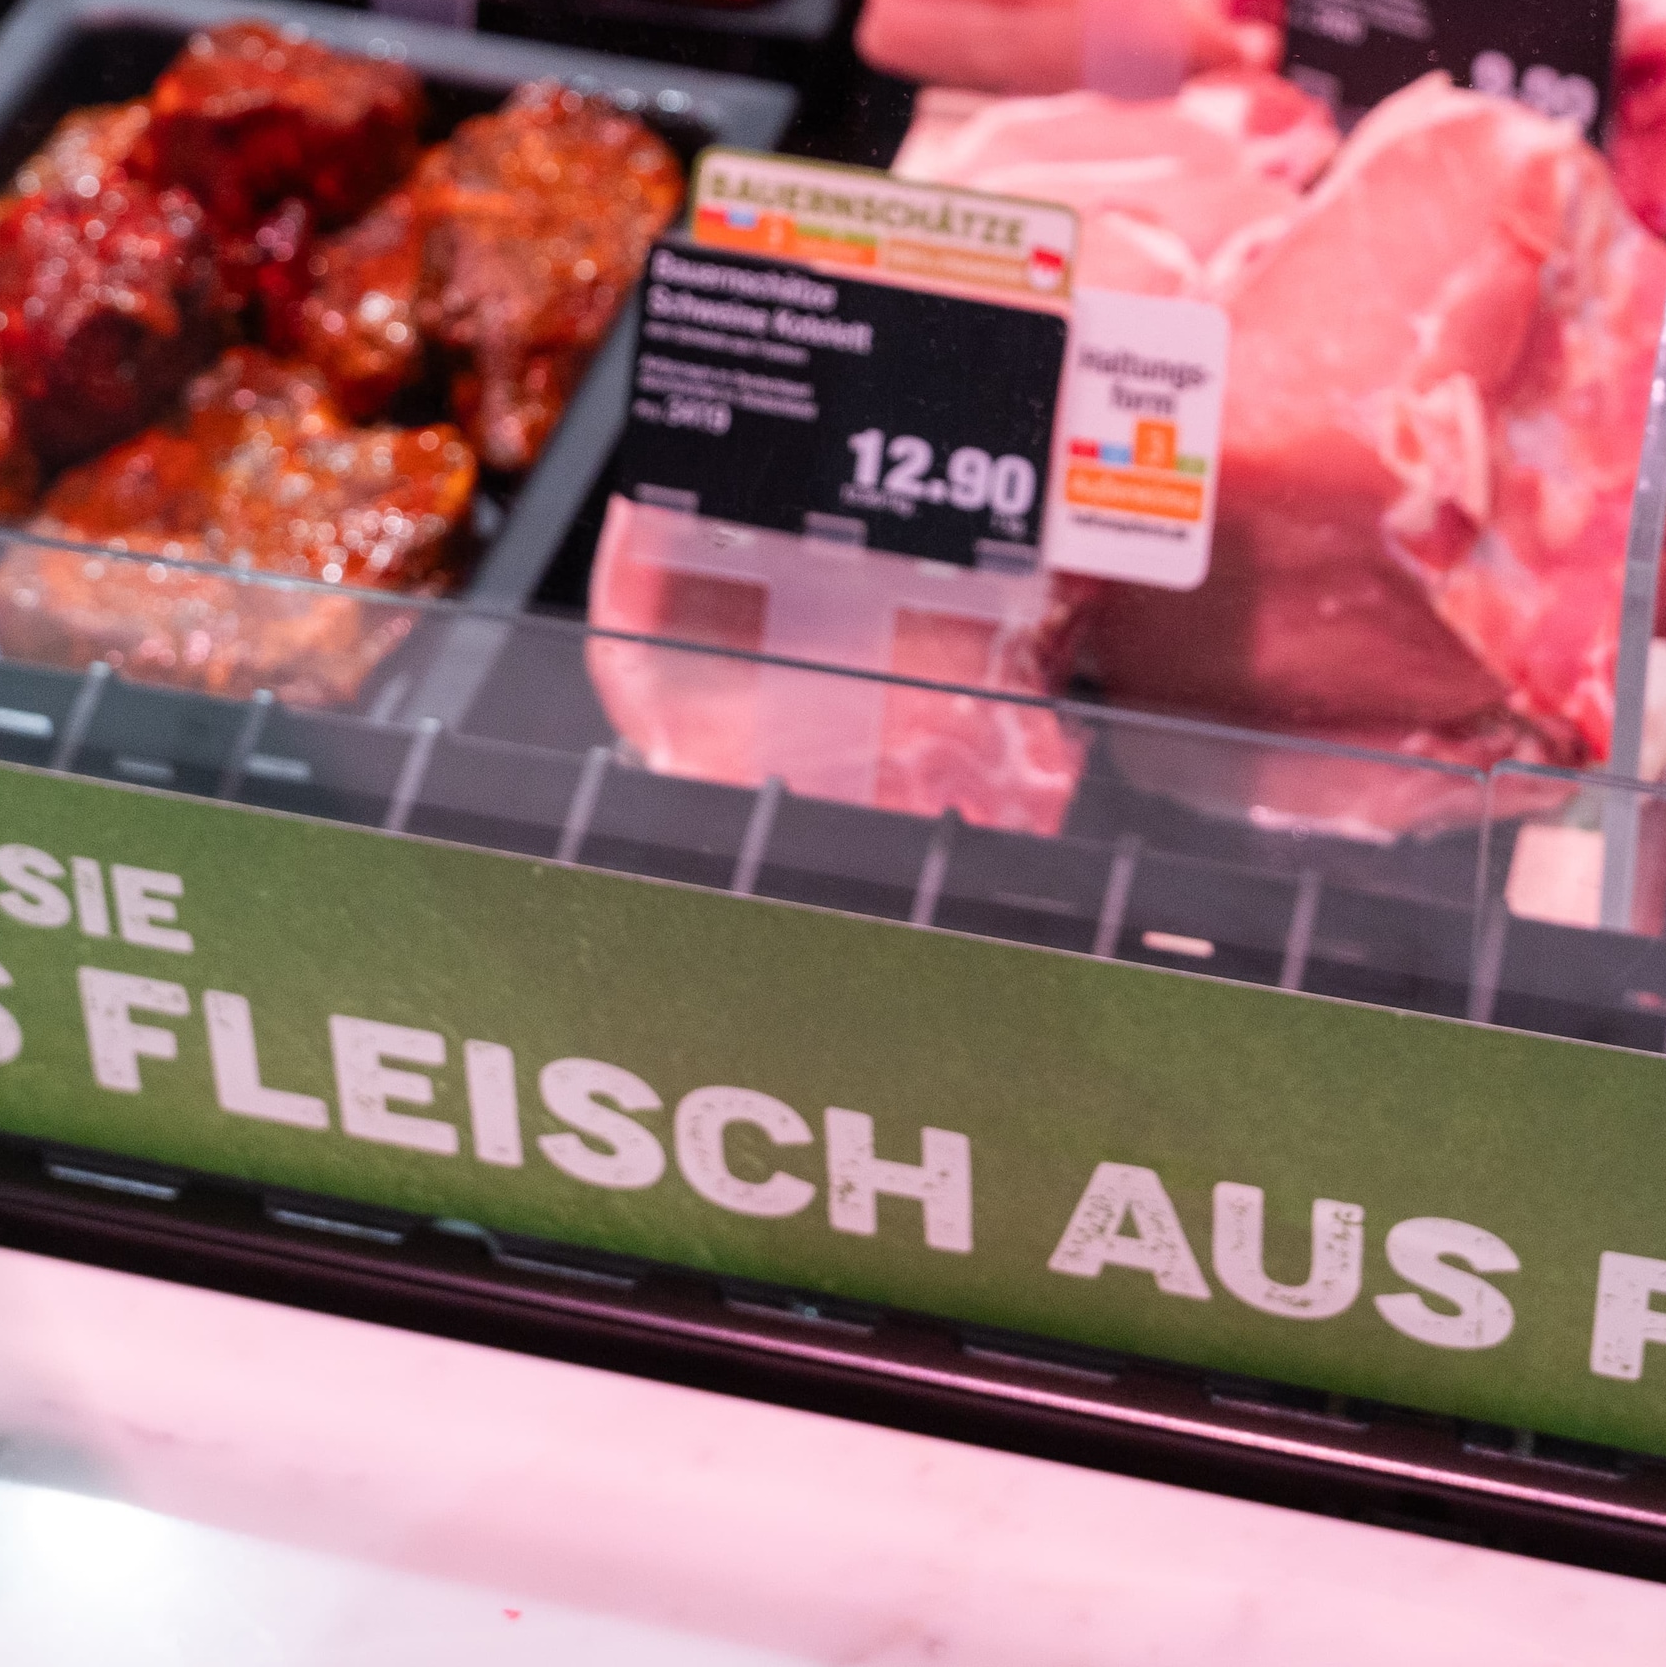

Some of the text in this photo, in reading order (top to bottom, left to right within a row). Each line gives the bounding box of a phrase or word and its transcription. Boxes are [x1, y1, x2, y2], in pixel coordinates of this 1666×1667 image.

[847, 427, 1038, 518] 12.90
[77, 965, 974, 1255] FLEISCH
[1047, 1161, 1522, 1350] AUS
